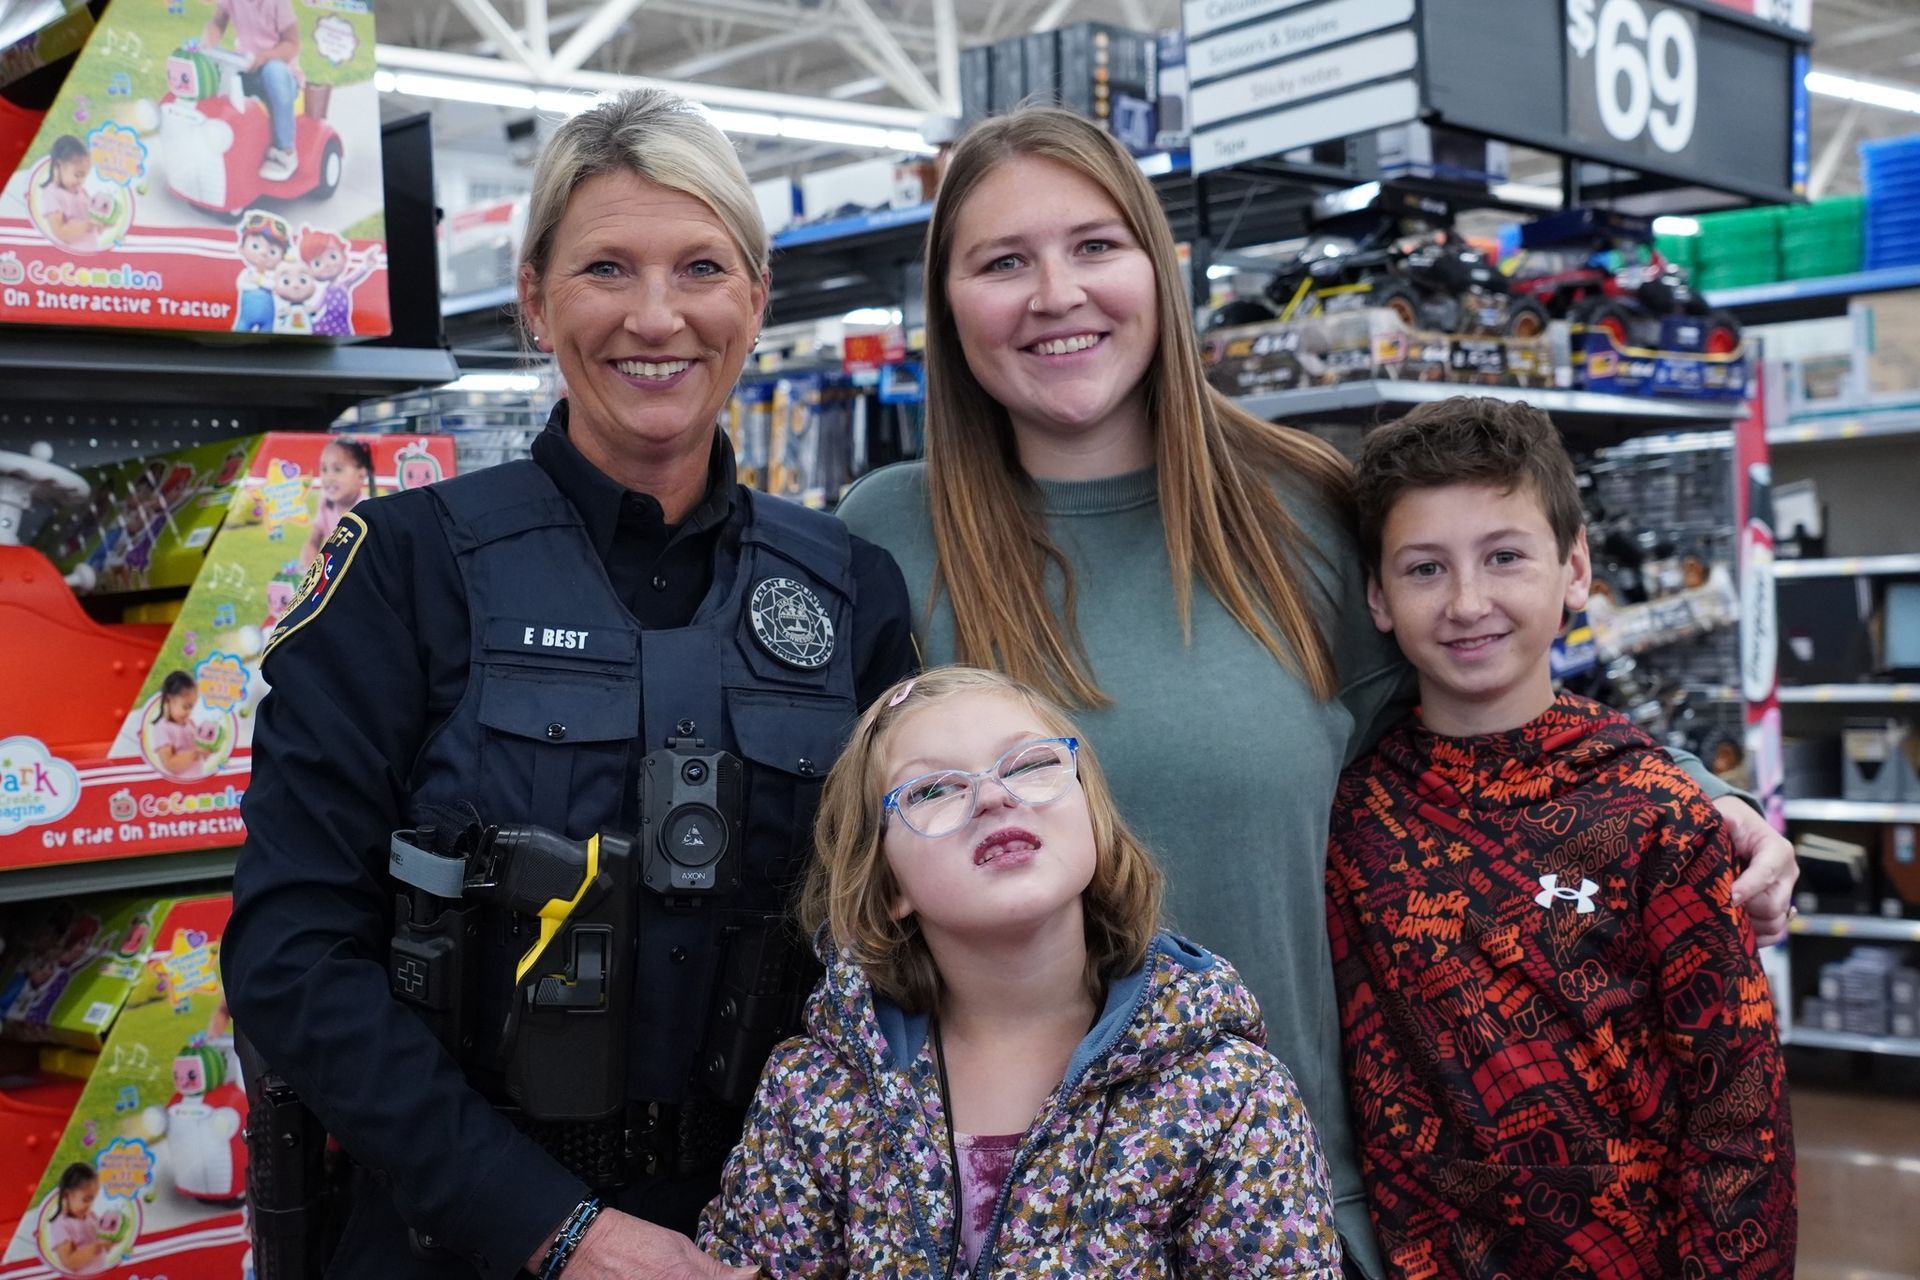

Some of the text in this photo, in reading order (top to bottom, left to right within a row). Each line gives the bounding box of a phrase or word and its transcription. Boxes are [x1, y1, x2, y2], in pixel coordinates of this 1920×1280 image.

[27, 260, 162, 291] CoComelon
[4, 288, 231, 318] On Interactive Tractor
[523, 626, 589, 650] E BEST
[0, 763, 58, 796] ark
[1480, 776, 1554, 806] ARMOUR
[140, 784, 243, 817] CoComelo
[73, 825, 113, 846] Ride
[119, 824, 144, 841] On
[149, 816, 246, 840] Interactiv
[681, 872, 706, 880] AXON
[1407, 889, 1471, 920] UNDER
[1394, 914, 1465, 945] ARMOUR
[1418, 955, 1464, 988] UNDER
